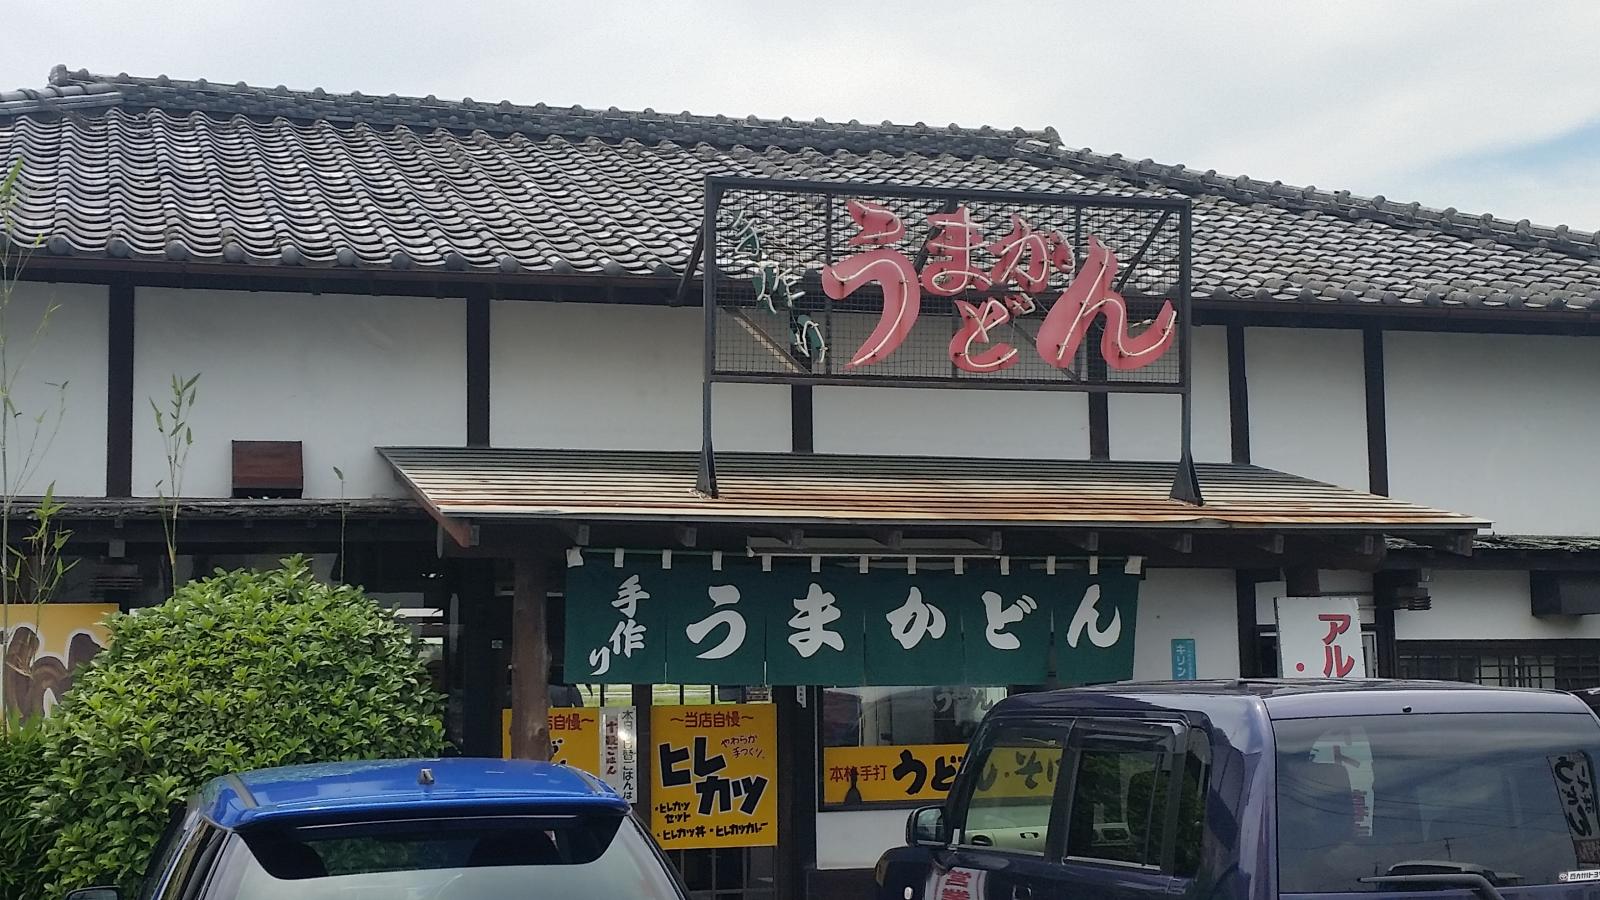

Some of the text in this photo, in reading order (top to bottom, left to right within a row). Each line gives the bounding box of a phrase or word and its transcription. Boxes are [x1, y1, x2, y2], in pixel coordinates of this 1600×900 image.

[589, 574, 650, 677] 手作り
[685, 582, 1121, 660] うまかどん
